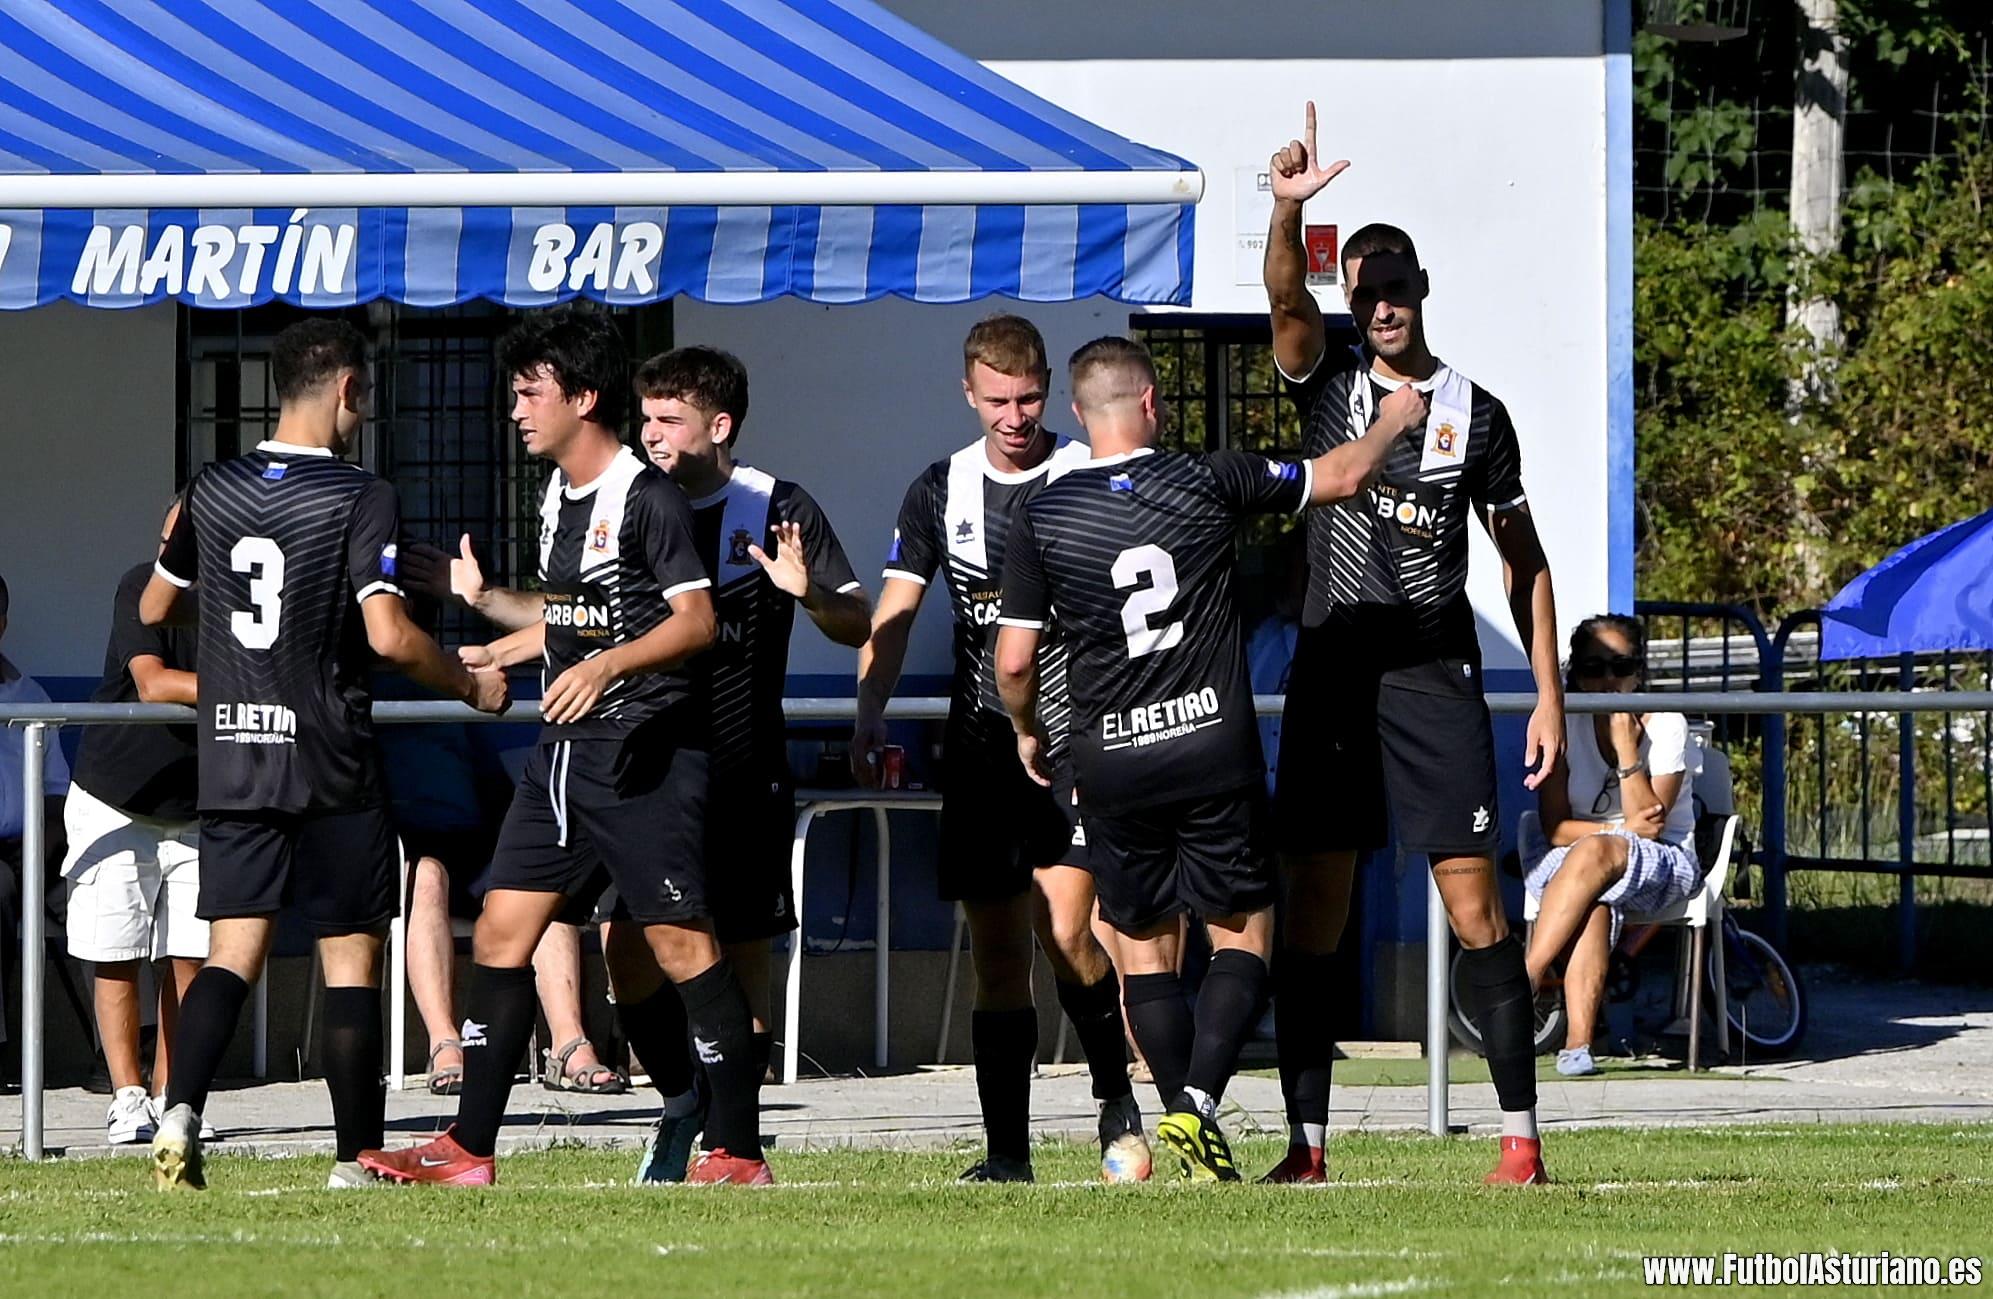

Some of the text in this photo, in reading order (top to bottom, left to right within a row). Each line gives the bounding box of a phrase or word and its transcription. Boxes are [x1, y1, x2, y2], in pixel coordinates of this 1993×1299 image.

[71, 208, 355, 299] MARTÍN
[527, 222, 663, 294] BAR
[230, 536, 286, 650] 3
[543, 595, 609, 628] ARBÓN
[1110, 543, 1185, 660] 2
[215, 703, 237, 730] EL
[1102, 686, 1219, 740] EL RETIRO
